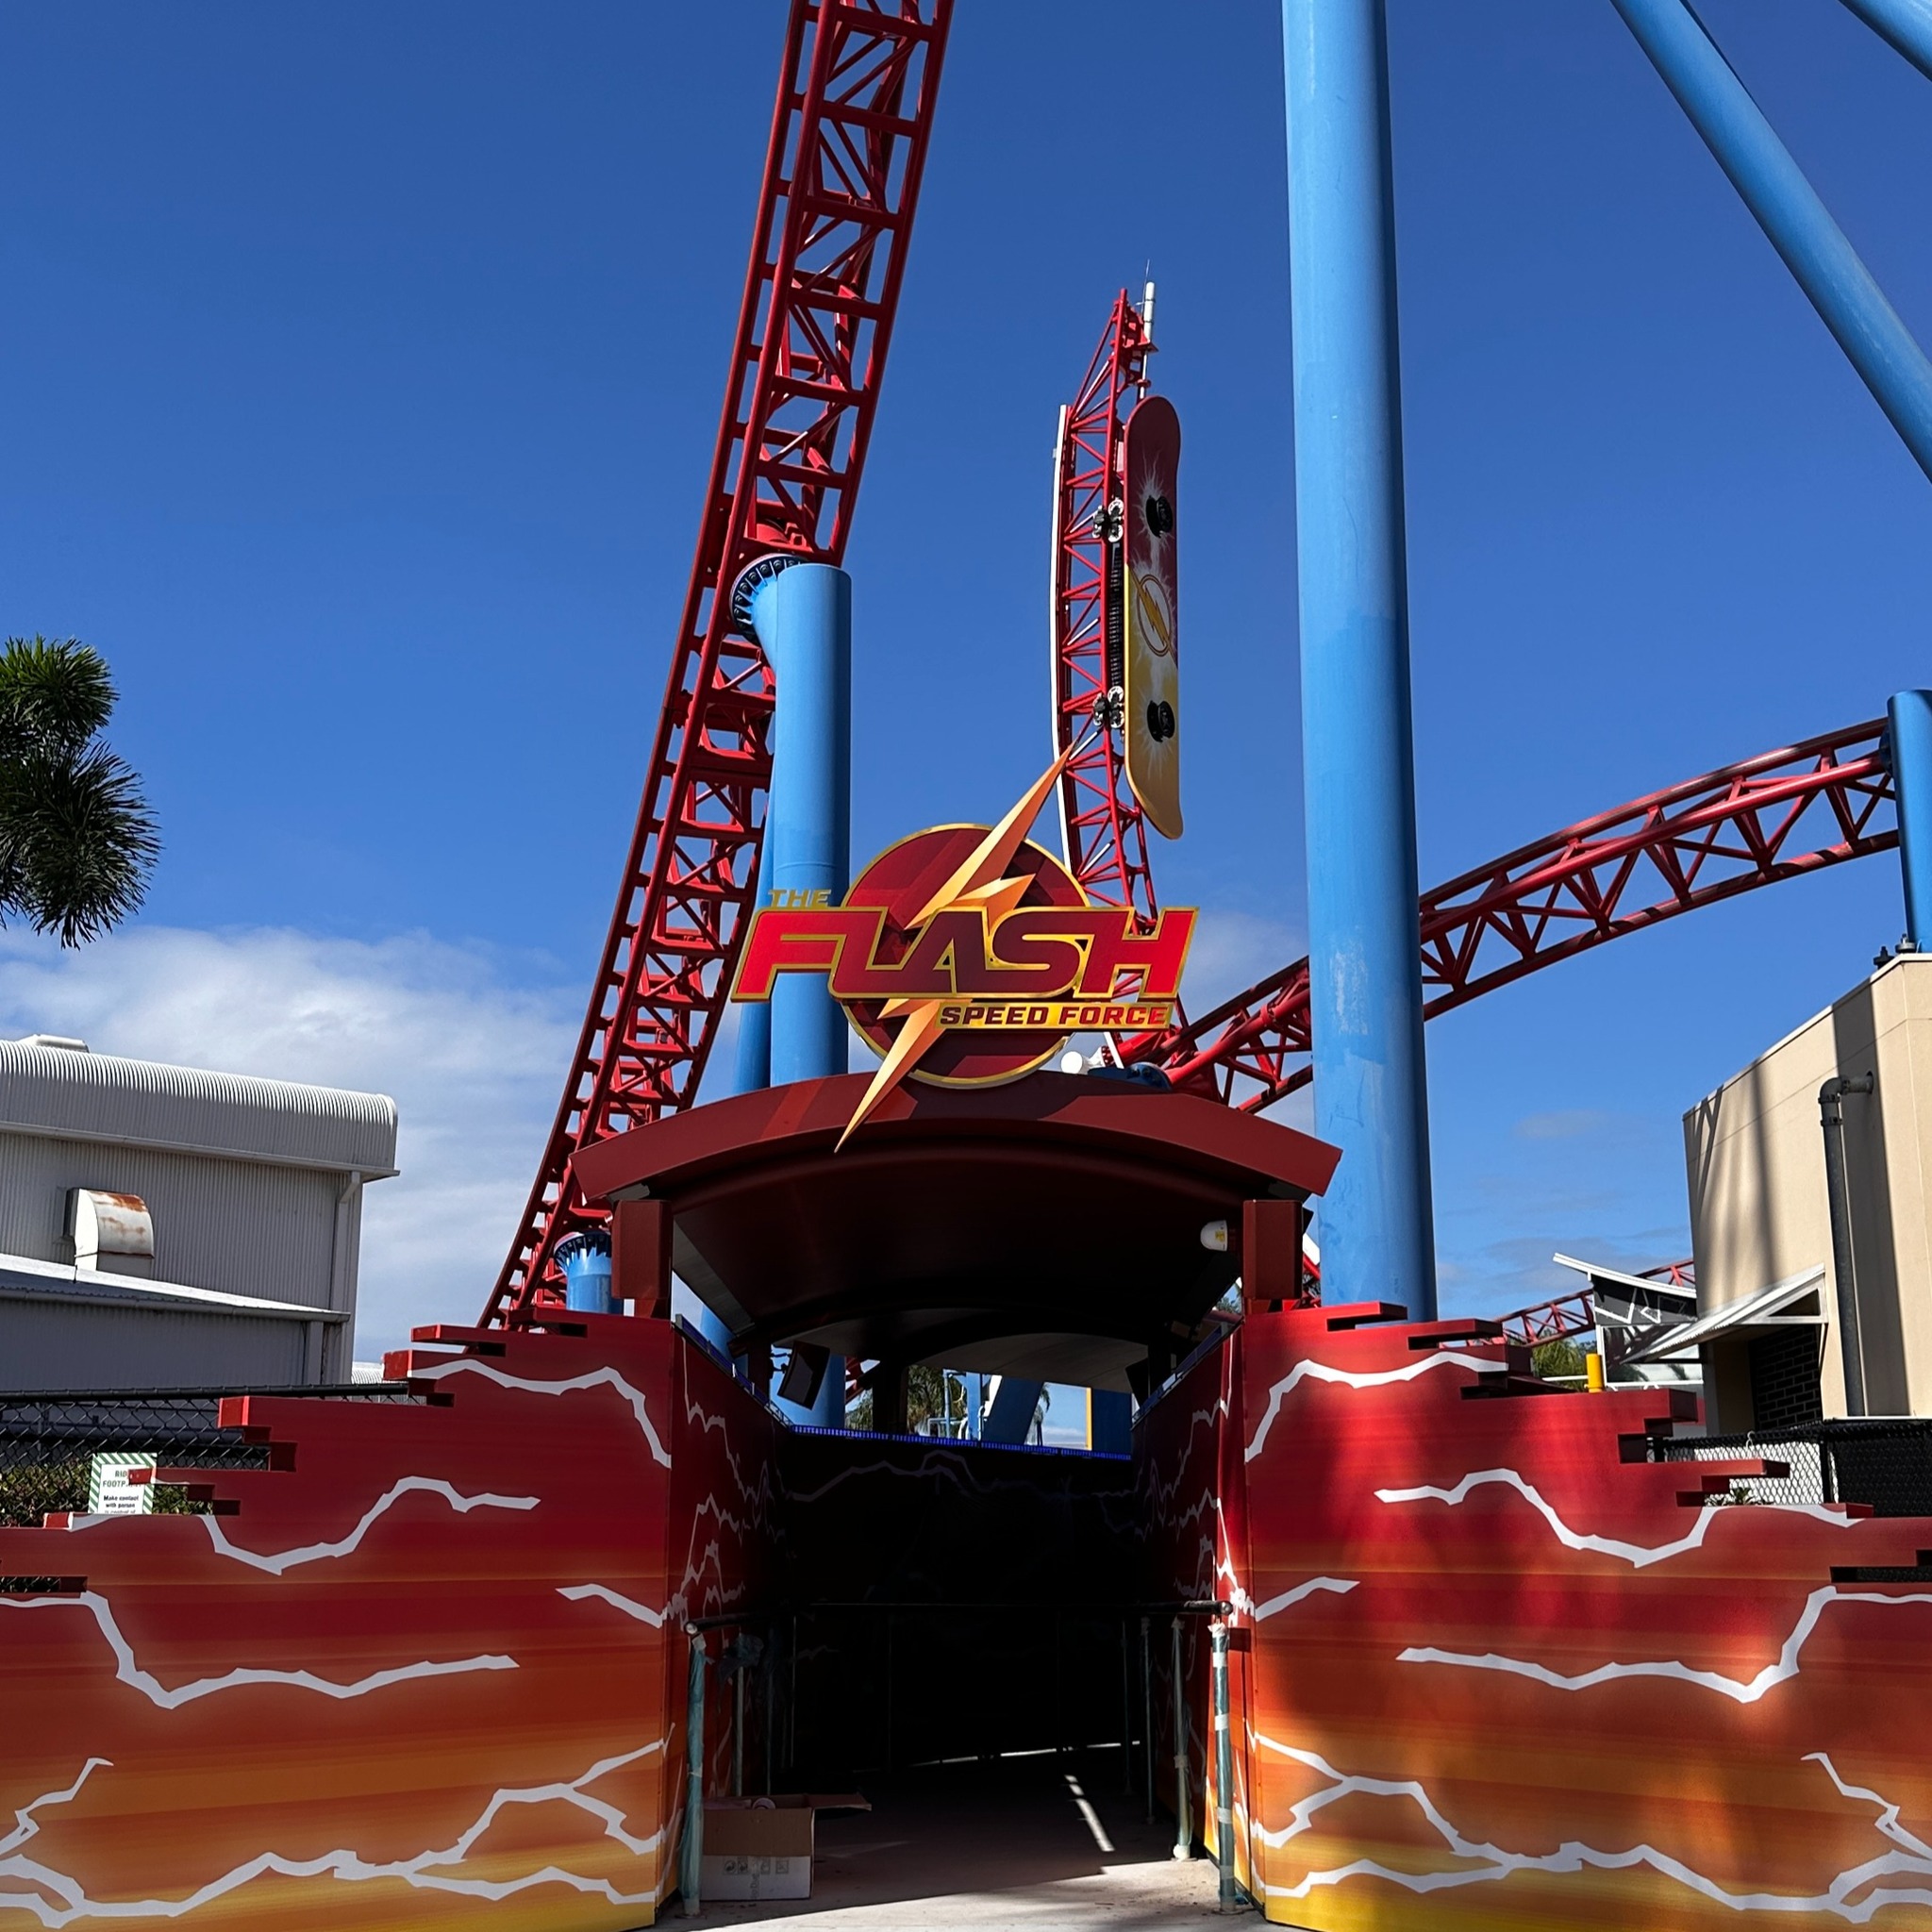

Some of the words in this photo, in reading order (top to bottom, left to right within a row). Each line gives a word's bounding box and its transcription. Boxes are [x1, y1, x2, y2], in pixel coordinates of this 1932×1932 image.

[768, 889, 831, 908] THE
[731, 908, 1198, 997] FLASH
[940, 1006, 1050, 1025] SPEED
[1058, 1006, 1169, 1025] FORCE
